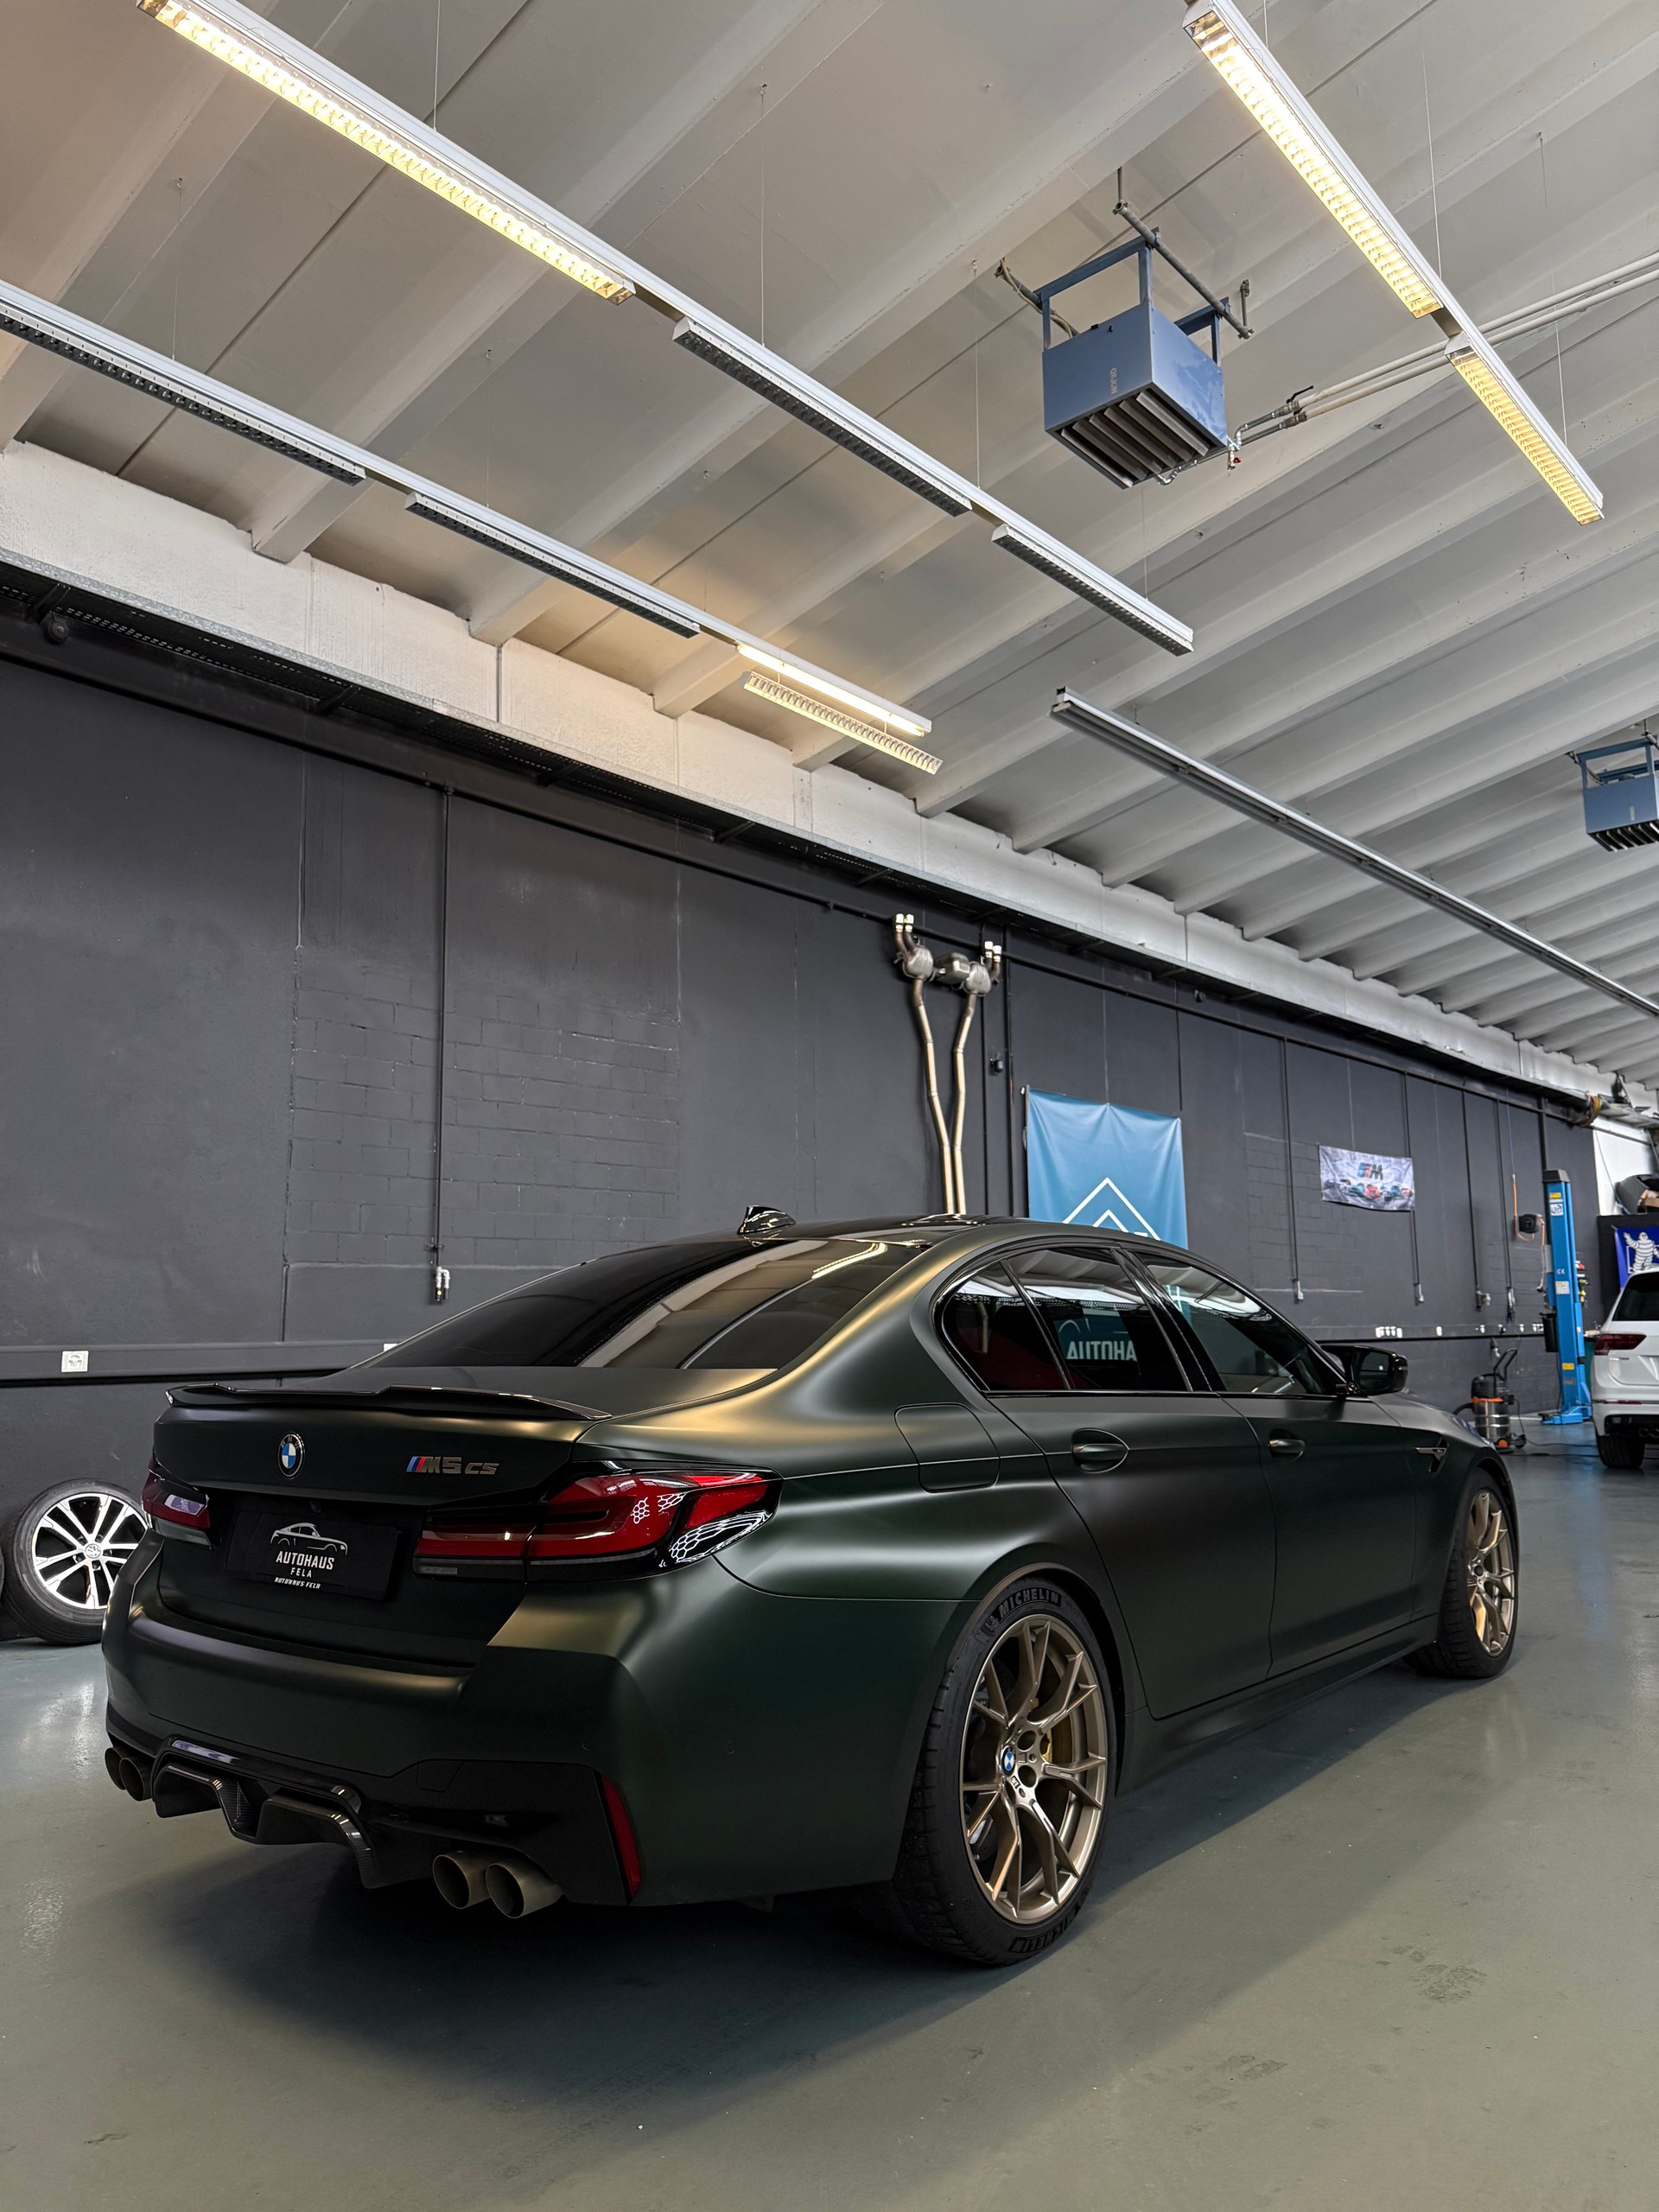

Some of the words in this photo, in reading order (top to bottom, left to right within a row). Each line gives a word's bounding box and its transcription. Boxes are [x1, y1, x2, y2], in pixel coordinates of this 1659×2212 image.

[417, 1456, 463, 1475] M5
[275, 1550, 335, 1571] AUTOHAUS
[274, 1576, 305, 1587] AUTOHAUS
[289, 1567, 313, 1579] FELA
[998, 1587, 1060, 1619] MICHELIN
